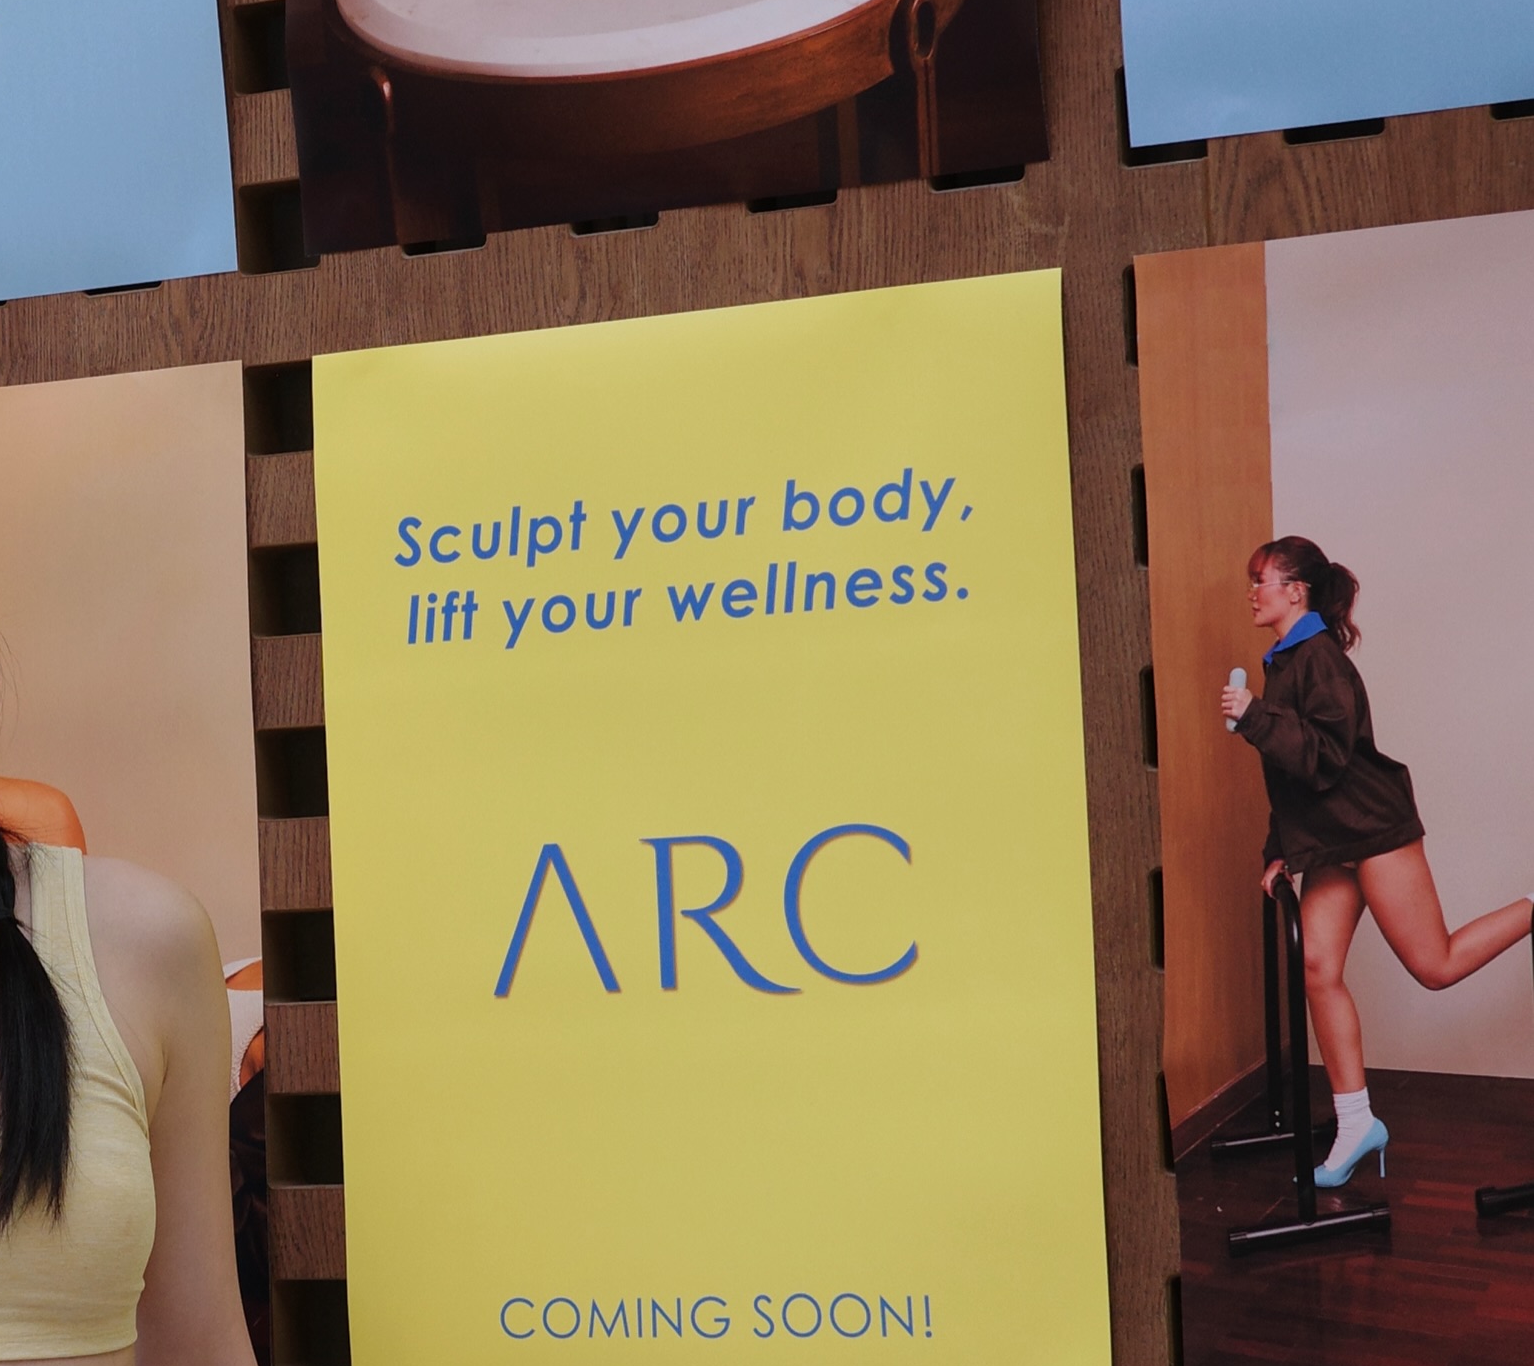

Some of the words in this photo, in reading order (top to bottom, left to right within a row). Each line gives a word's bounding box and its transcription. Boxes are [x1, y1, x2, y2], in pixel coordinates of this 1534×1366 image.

[395, 500, 587, 568] Sculpt
[612, 496, 758, 560] your
[782, 468, 972, 532] body,
[408, 590, 478, 644] lift
[503, 588, 642, 649] your
[667, 562, 969, 622] wellness.
[494, 823, 919, 998] ARC
[500, 1296, 731, 1339] COMING
[753, 1293, 934, 1339] SOON!
